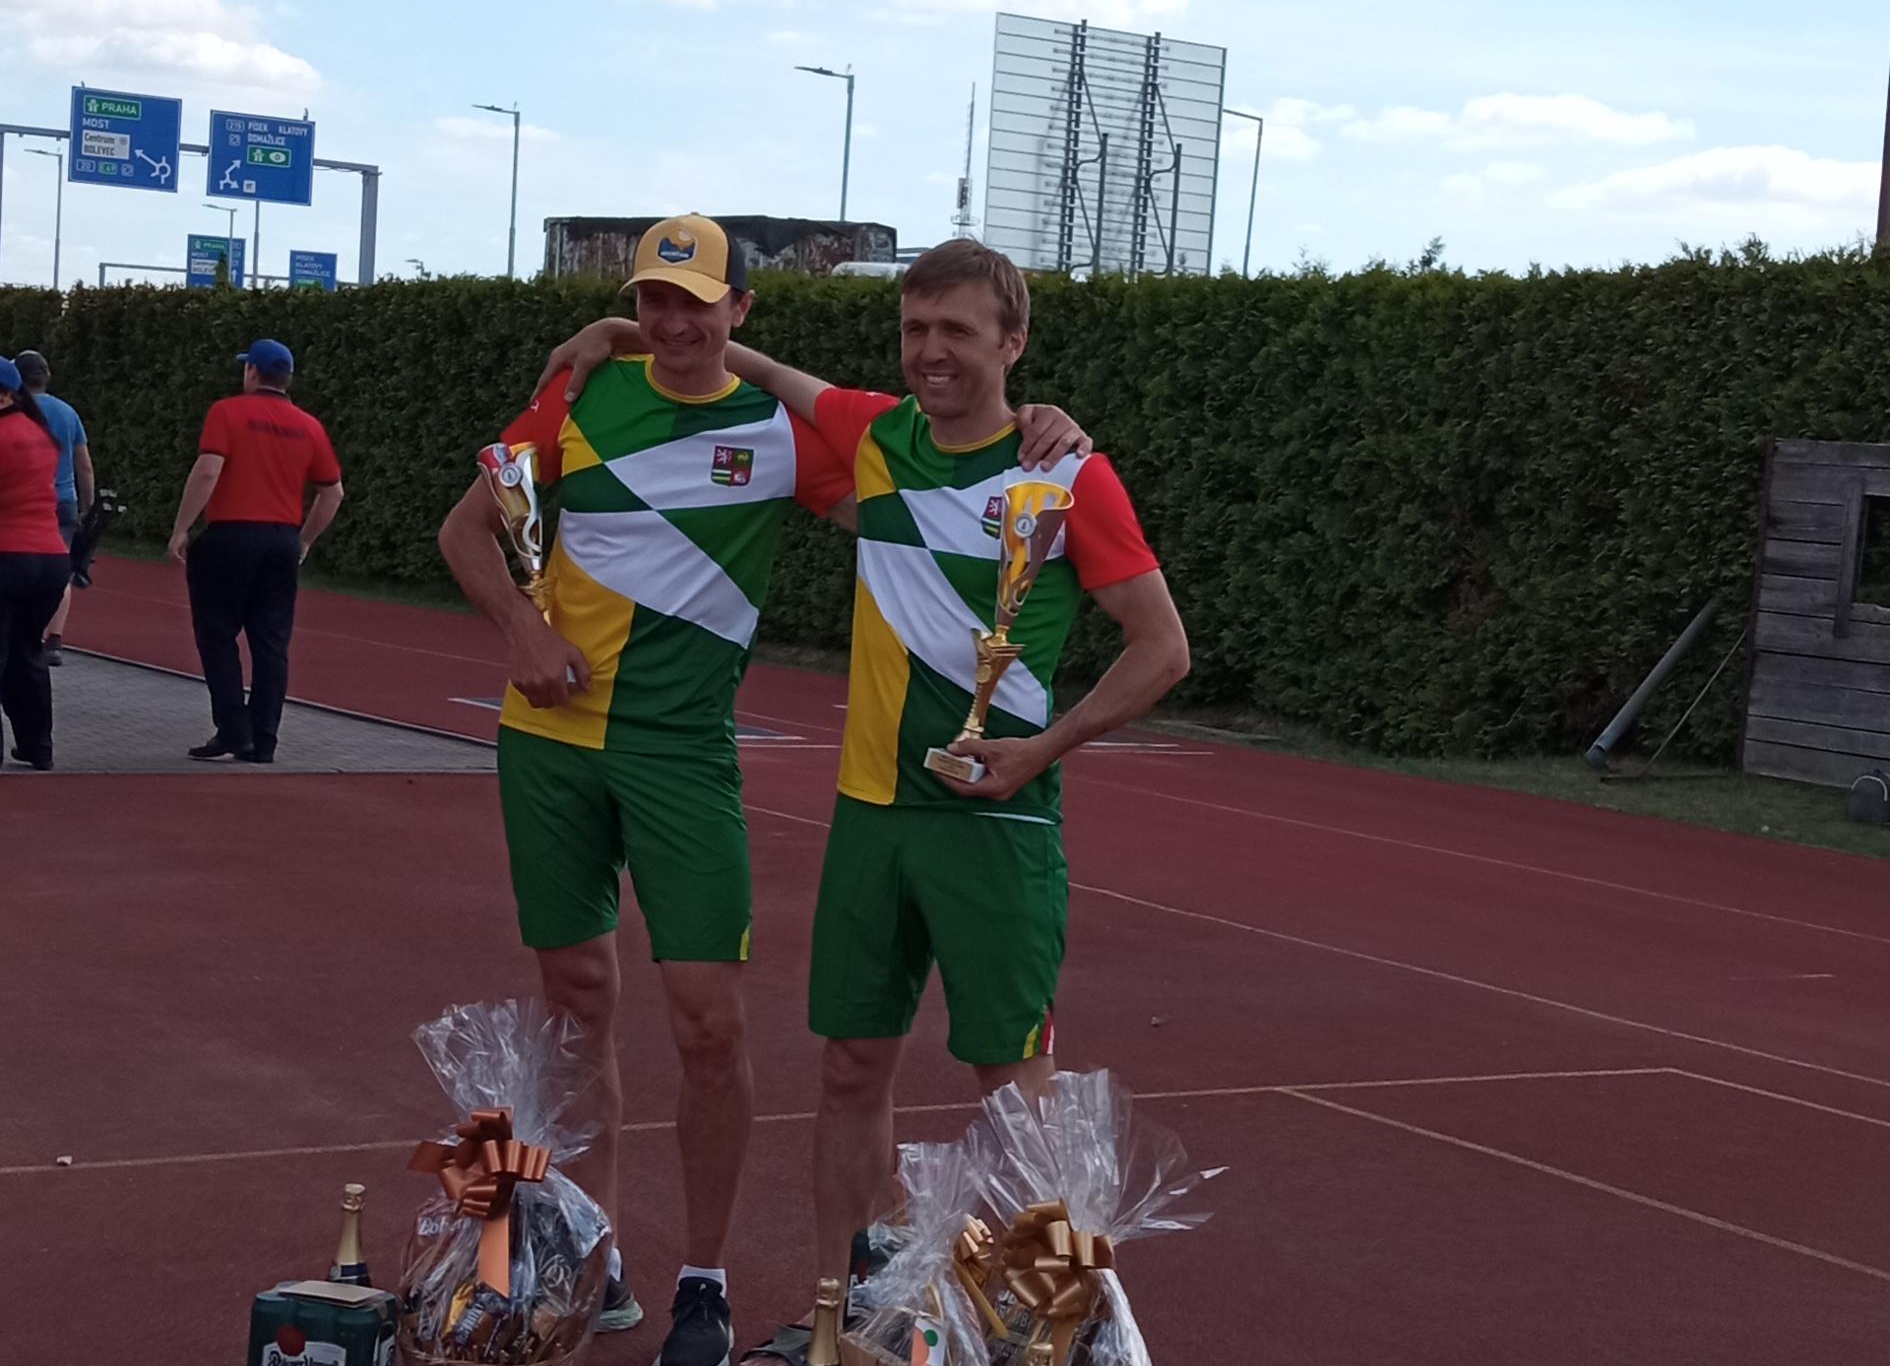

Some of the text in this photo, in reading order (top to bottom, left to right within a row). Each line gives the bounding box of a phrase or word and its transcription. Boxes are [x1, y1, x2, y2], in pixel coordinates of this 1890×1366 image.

[101, 102, 137, 115] PRAHA
[82, 117, 110, 129] MOST
[84, 132, 115, 144] Centrum
